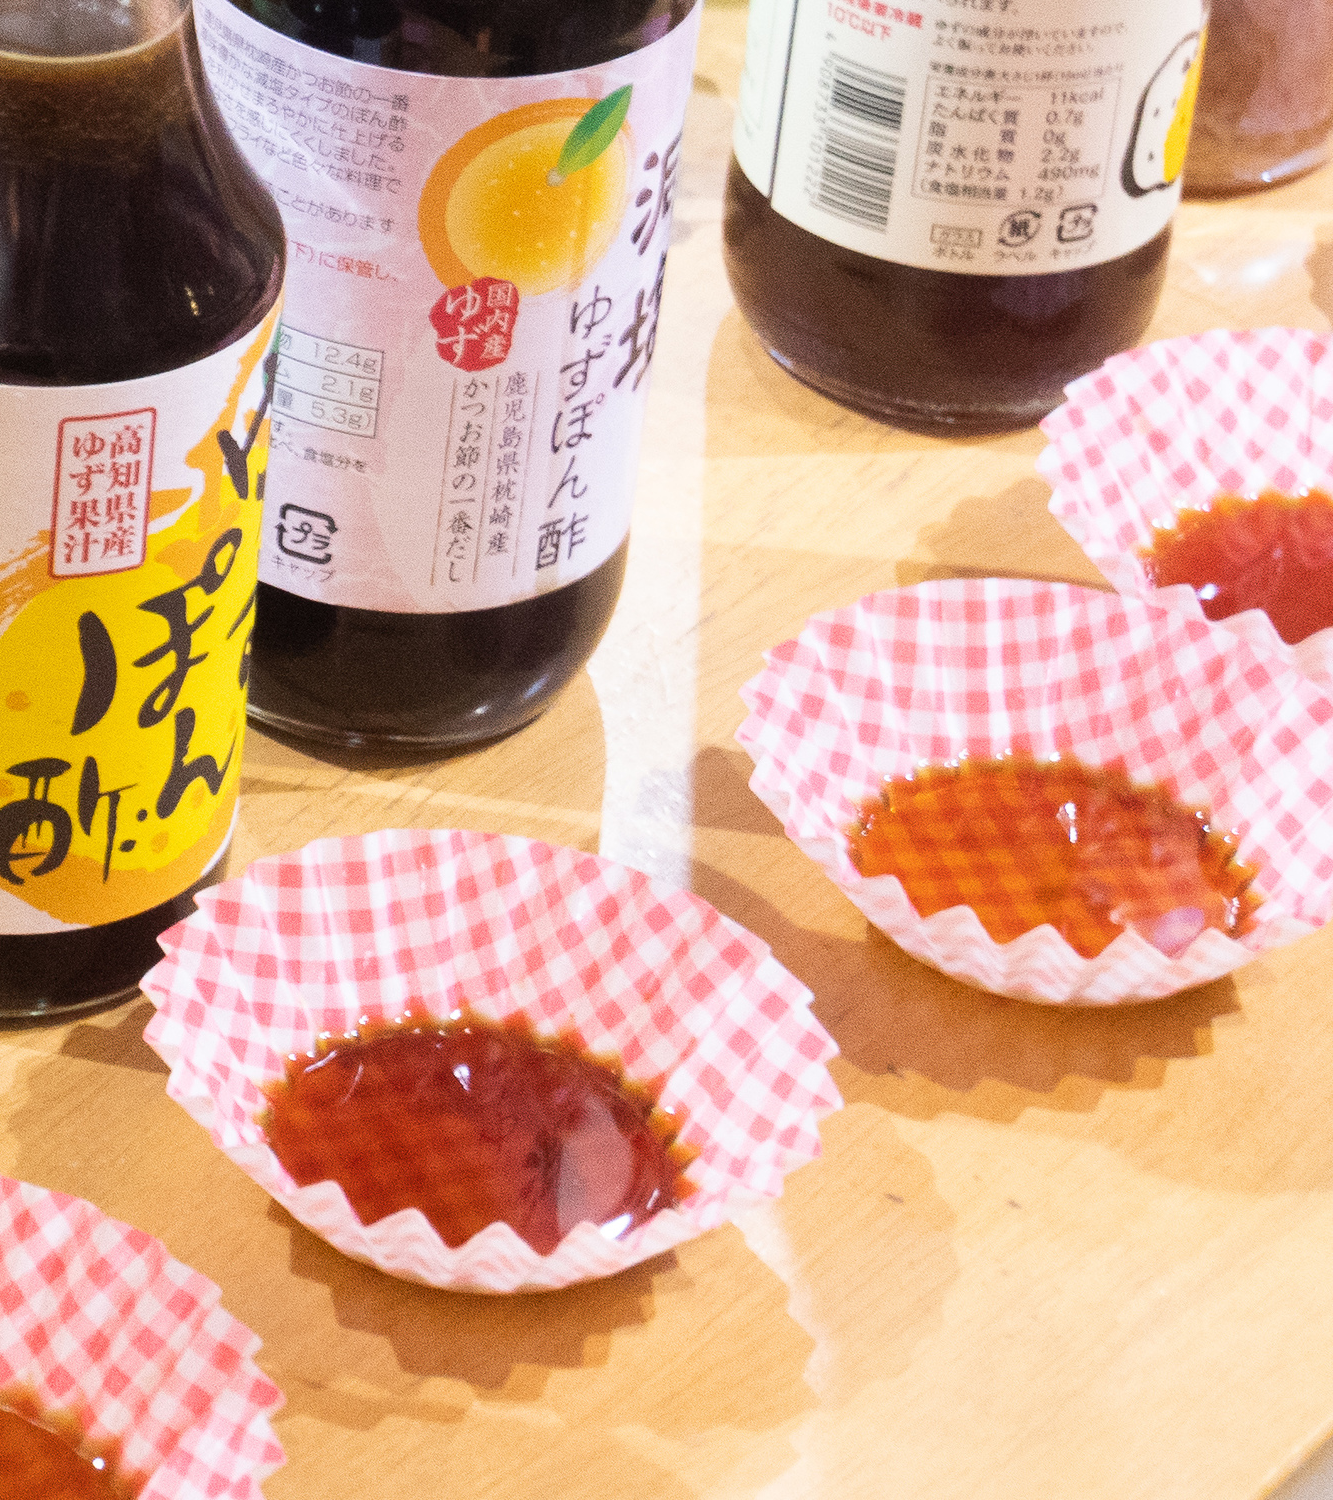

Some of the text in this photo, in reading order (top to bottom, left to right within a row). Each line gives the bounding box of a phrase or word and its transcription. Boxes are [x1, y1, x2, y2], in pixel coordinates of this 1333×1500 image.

[314, 341, 377, 374] 12.4g
[321, 374, 376, 404] 2.1g
[436, 285, 483, 364] ゆず
[100, 424, 144, 560] 高知県産
[445, 377, 488, 584] かつお節の一番だし
[486, 370, 529, 556] 鹿児島県枕崎産
[535, 284, 613, 572] ゆずぽん酢
[64, 430, 106, 565] ゆず果汁
